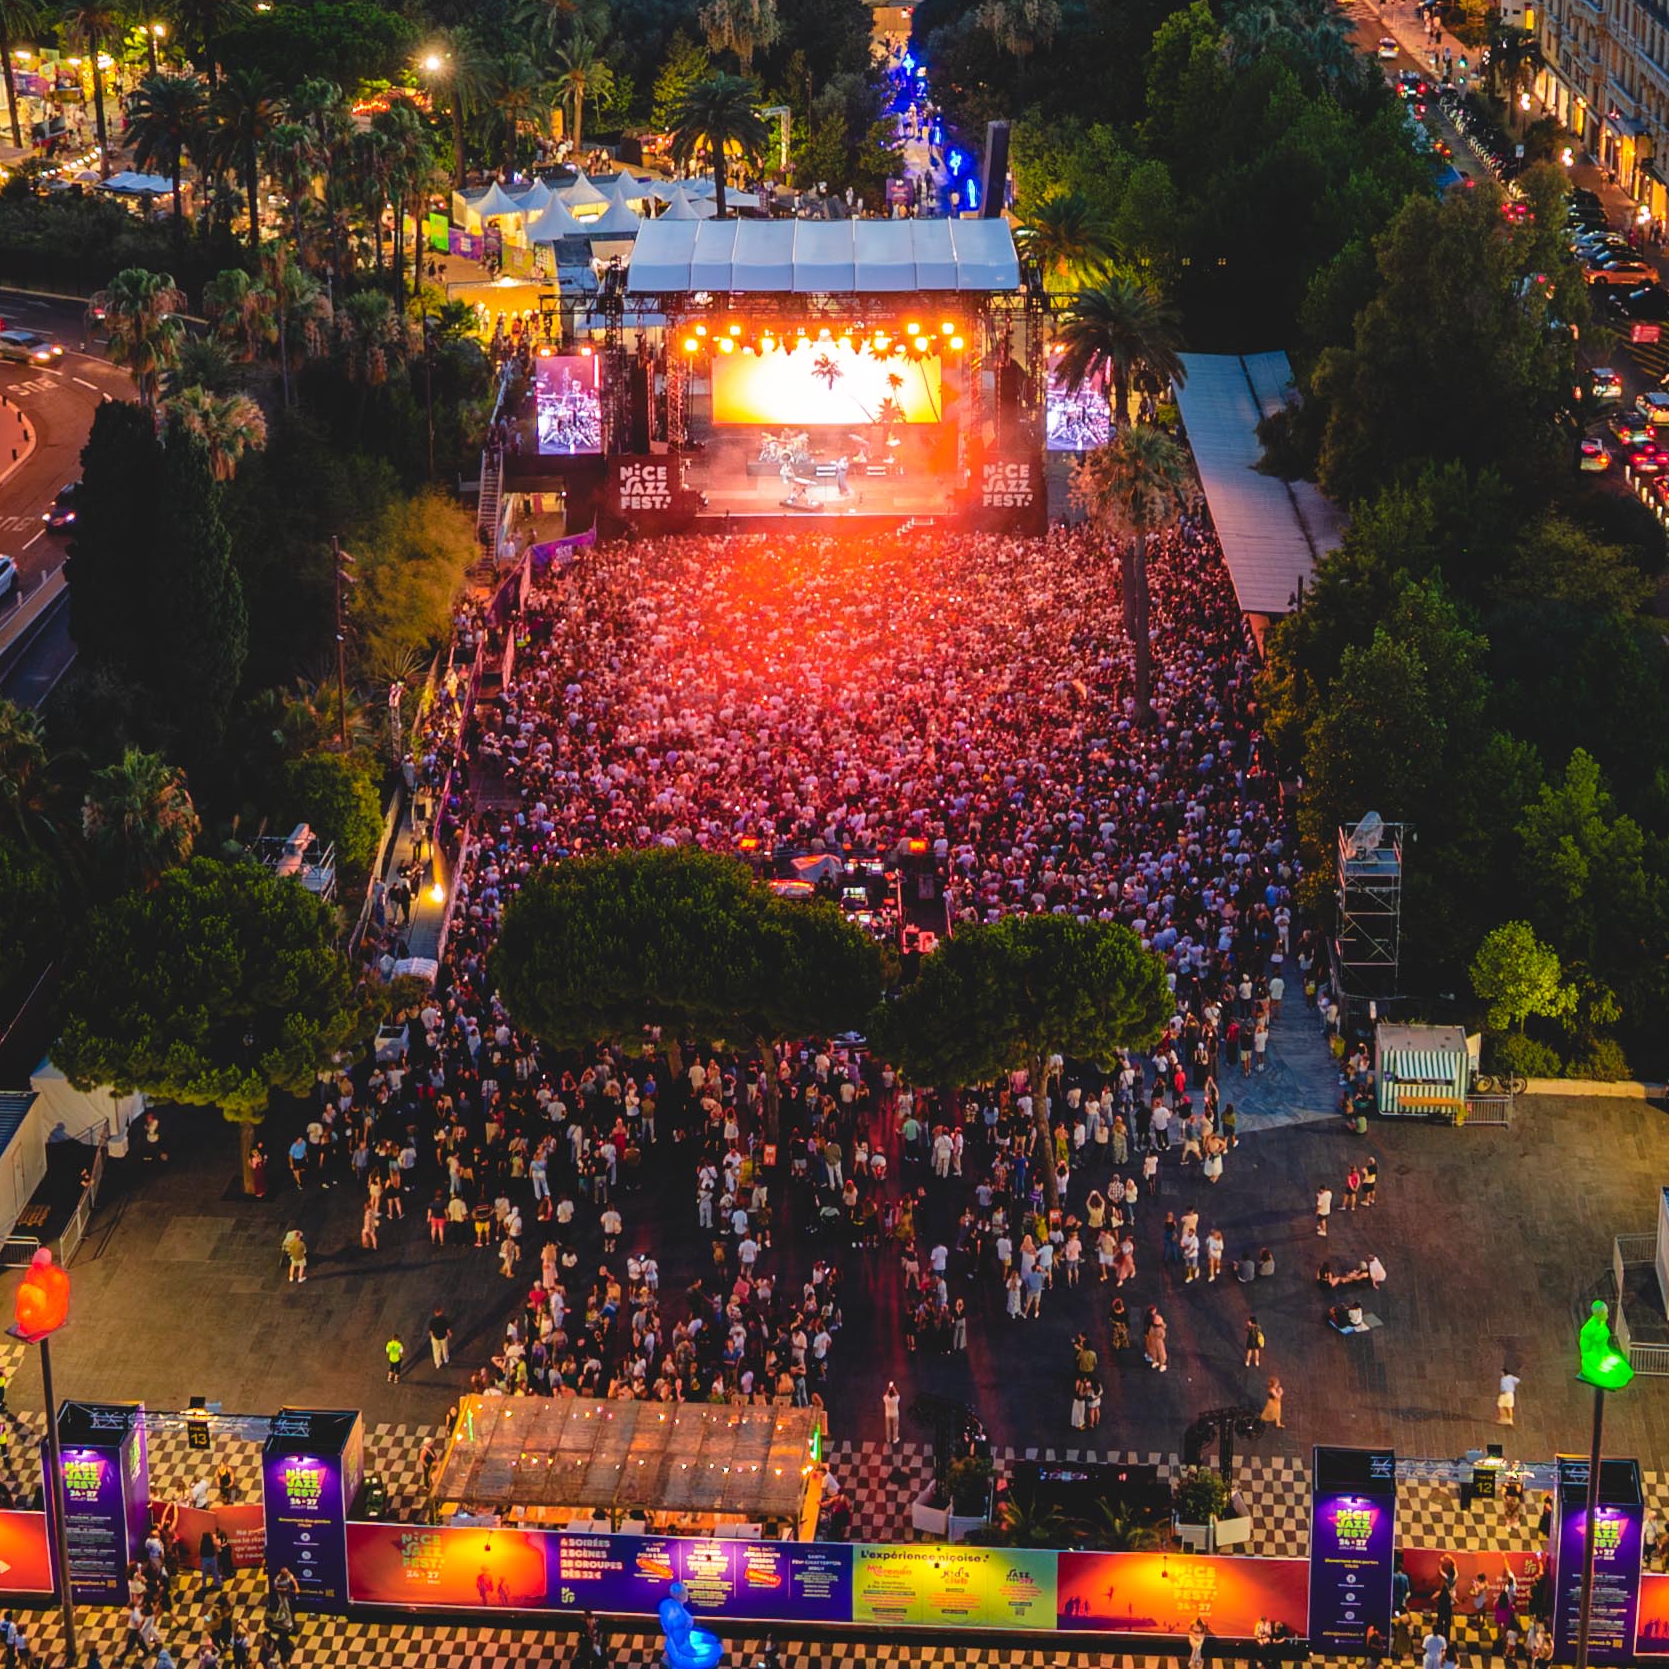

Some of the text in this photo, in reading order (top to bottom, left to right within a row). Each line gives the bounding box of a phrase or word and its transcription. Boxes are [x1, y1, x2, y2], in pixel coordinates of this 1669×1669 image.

[620, 476, 670, 495] JAZZ
[982, 474, 1031, 492] JAZZ
[191, 1433, 207, 1444] 13
[66, 1470, 100, 1480] JAZZ
[286, 1476, 321, 1488] JAZZ
[1476, 1484, 1491, 1493] 12
[1336, 1516, 1372, 1529] JAZZ
[569, 1538, 610, 1547] SOIRÉES
[402, 1542, 443, 1557] JAZZ
[569, 1548, 607, 1558] SCÈNES
[861, 1550, 935, 1560] L'expérience
[939, 1553, 981, 1563] niçoise
[575, 1560, 623, 1570] GROUPES
[1174, 1575, 1217, 1589] JAZZ
